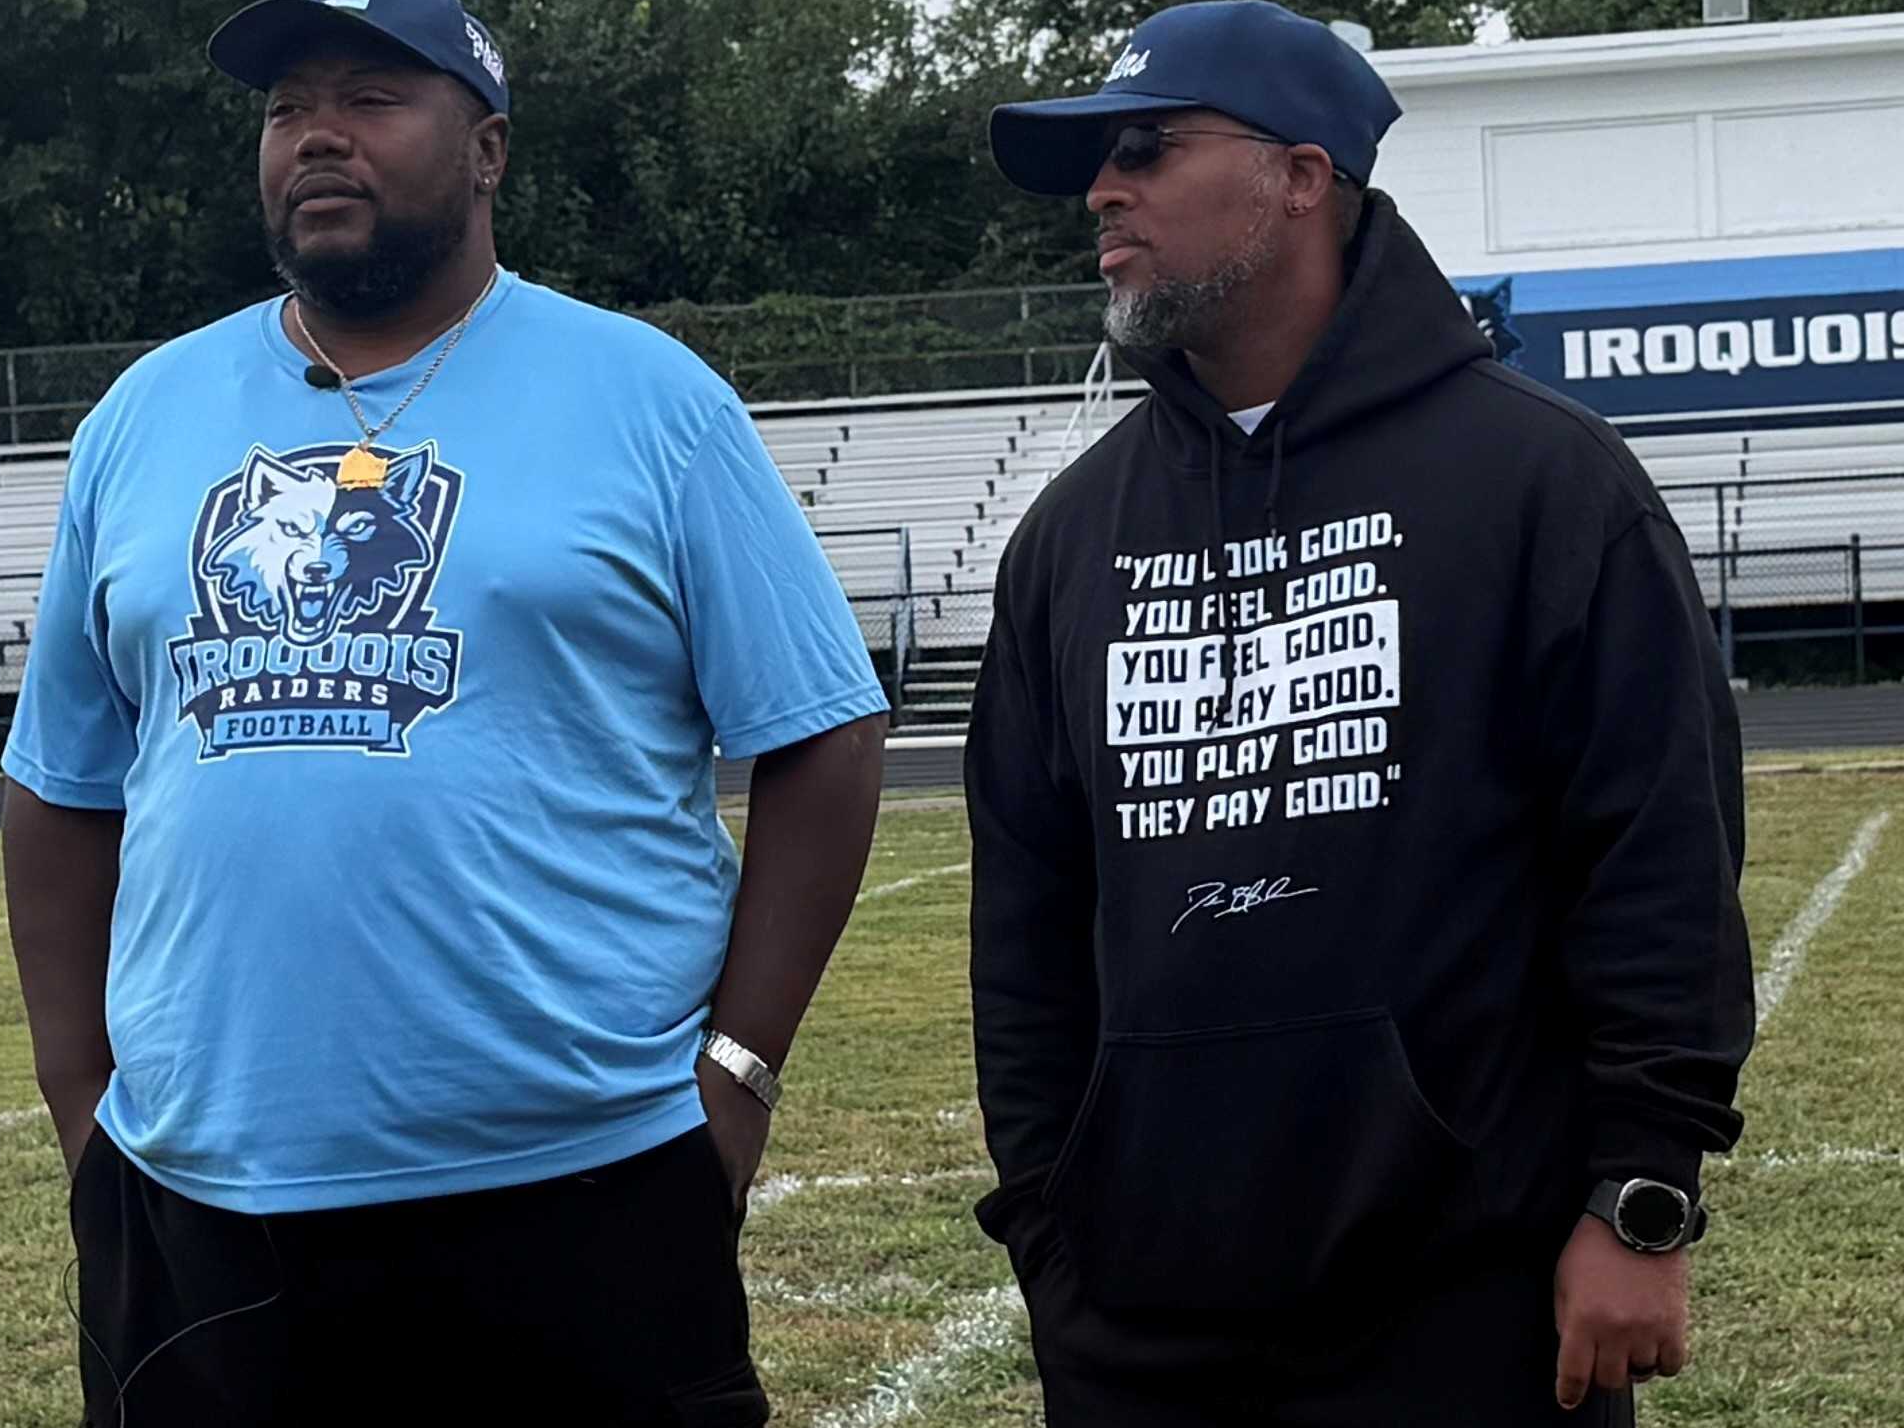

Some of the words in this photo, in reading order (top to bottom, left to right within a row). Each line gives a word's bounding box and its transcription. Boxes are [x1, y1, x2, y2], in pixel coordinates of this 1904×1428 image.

[1115, 553, 1197, 590] "YOU
[1301, 512, 1403, 564] GOOD,
[1125, 599, 1192, 636] YOU
[1286, 562, 1388, 615] GOOD.
[174, 632, 453, 709] IROQUOIS
[1122, 648, 1188, 685] YOU
[1285, 612, 1387, 665] GOOD,
[218, 678, 389, 710] RAIDERS
[226, 714, 373, 740] FOOTBALL
[1116, 699, 1181, 737] YOU
[1289, 664, 1395, 714] GOOD.
[1120, 748, 1184, 788] YOU
[1196, 733, 1279, 782] PLAY
[1293, 716, 1388, 766] GOOD
[1115, 798, 1196, 839] THEY
[1205, 786, 1272, 831] PAY
[1285, 764, 1402, 819] GOOD."
